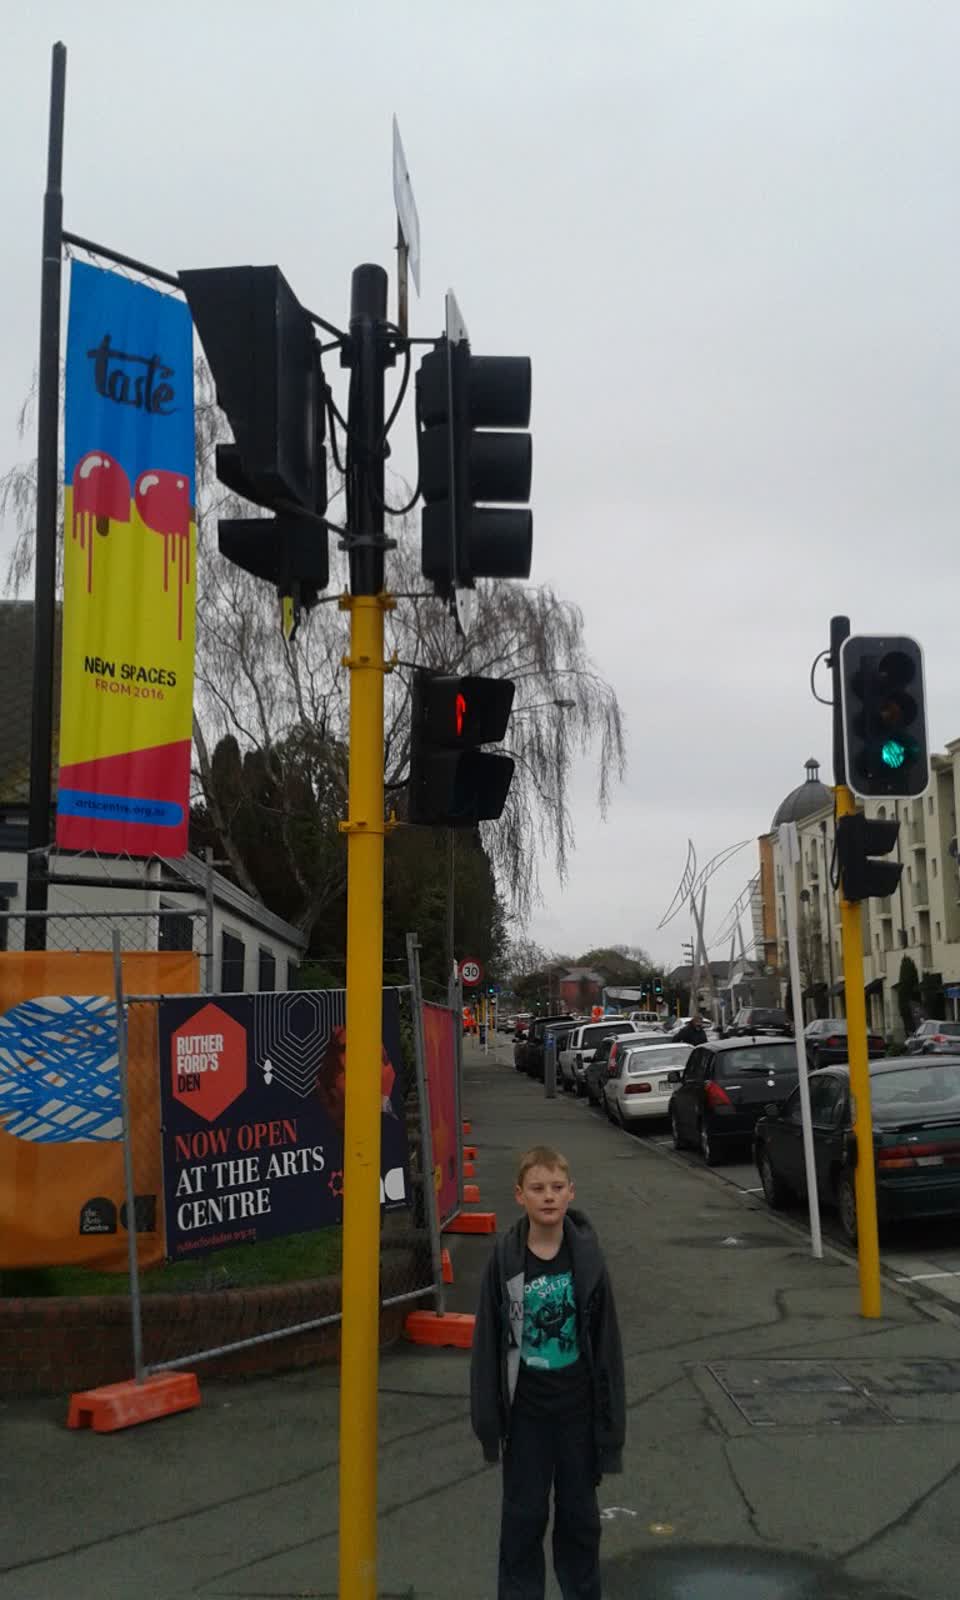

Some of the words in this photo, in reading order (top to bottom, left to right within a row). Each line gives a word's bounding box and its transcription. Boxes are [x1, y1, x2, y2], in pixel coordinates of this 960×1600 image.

[87, 334, 176, 416] taste
[84, 655, 116, 678] NEW
[121, 663, 177, 687] SPACES
[95, 679, 131, 696] FROM
[133, 686, 165, 700] 2016
[464, 966, 478, 977] 30
[176, 1034, 224, 1056] RUTHER
[176, 1053, 219, 1075] FORD'S
[178, 1073, 201, 1093] DEN
[175, 1128, 231, 1162] NOW
[237, 1119, 298, 1150] OPEN
[175, 1165, 207, 1197] AT
[212, 1157, 260, 1189] THE
[265, 1146, 325, 1180] ARTS
[177, 1187, 272, 1231] CENTRE
[524, 1276, 547, 1294] OCK
